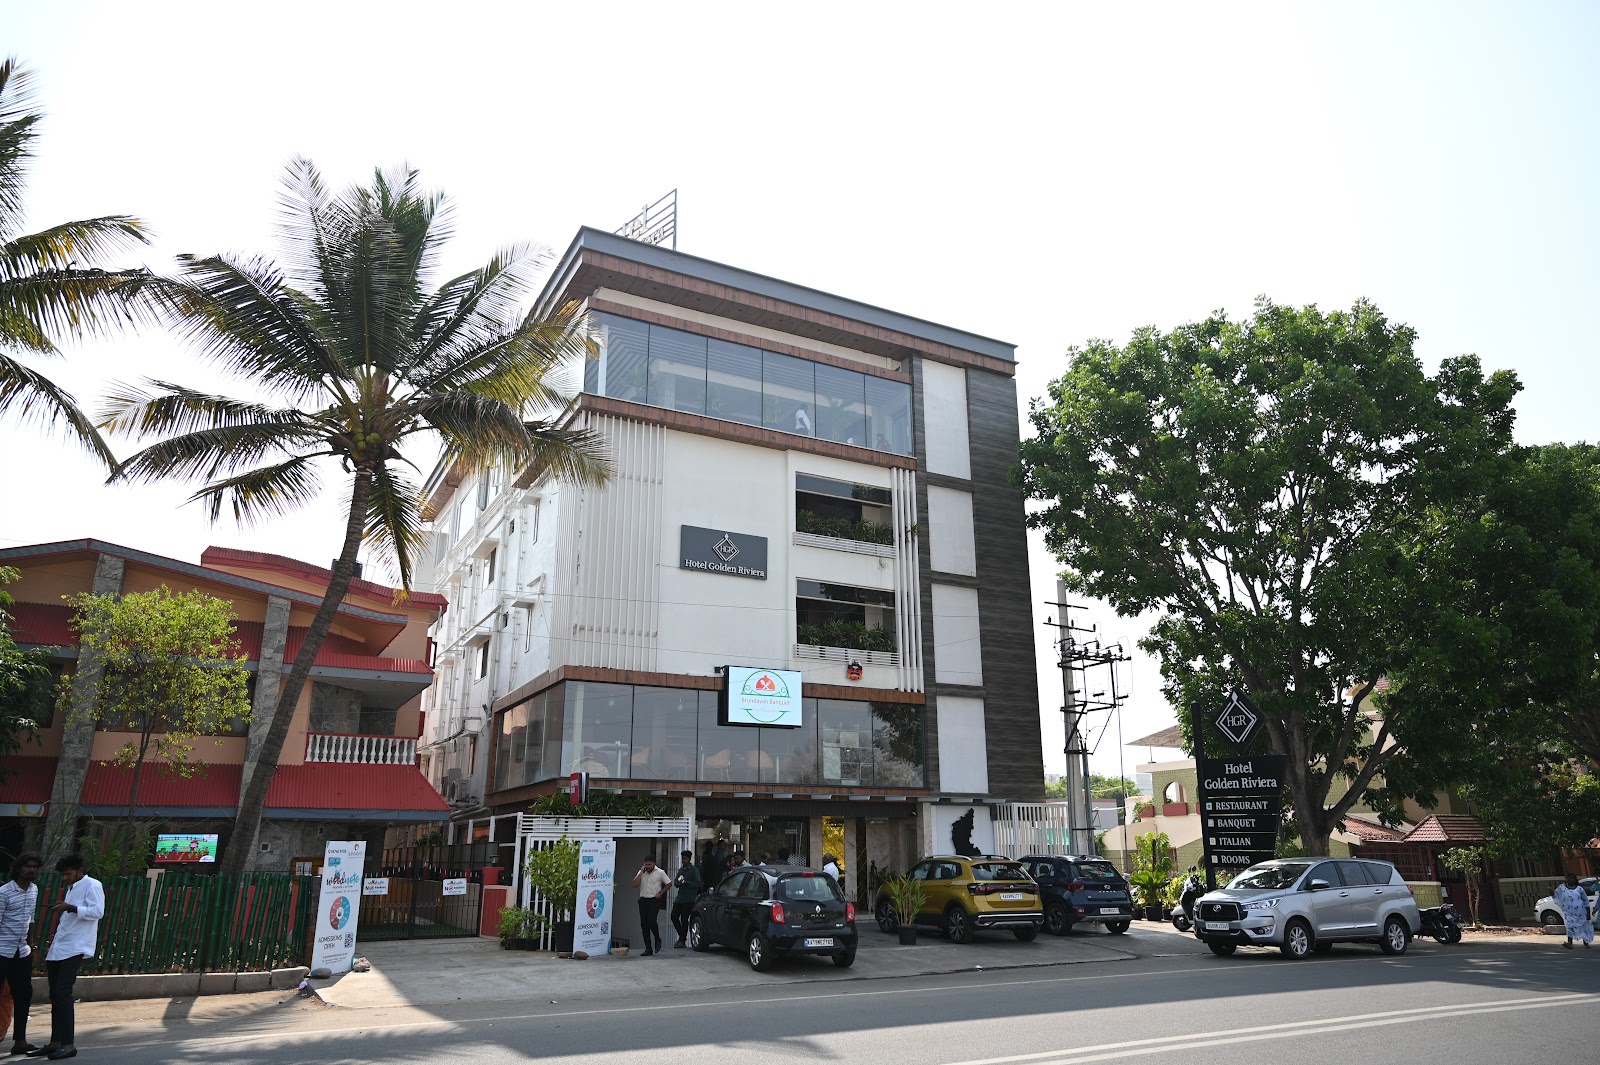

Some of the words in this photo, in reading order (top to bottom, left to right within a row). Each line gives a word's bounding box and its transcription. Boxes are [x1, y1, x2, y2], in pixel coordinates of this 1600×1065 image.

[720, 545, 734, 554] HGR
[684, 558, 707, 569] Hotel
[708, 562, 737, 573] Golden
[738, 565, 765, 577] Riviera
[1227, 714, 1247, 727] HGR
[1225, 761, 1253, 774] Hotel
[1204, 777, 1239, 790] Golden
[1241, 776, 1278, 788] Riviera
[1215, 800, 1268, 810] RESTAURANT
[1217, 818, 1256, 828] BANQUET
[1219, 837, 1251, 846] ITALIAN
[1221, 855, 1250, 865] ROOMS
[577, 922, 600, 930] ADMISSIONS
[317, 934, 343, 944] ADMISSIONS
